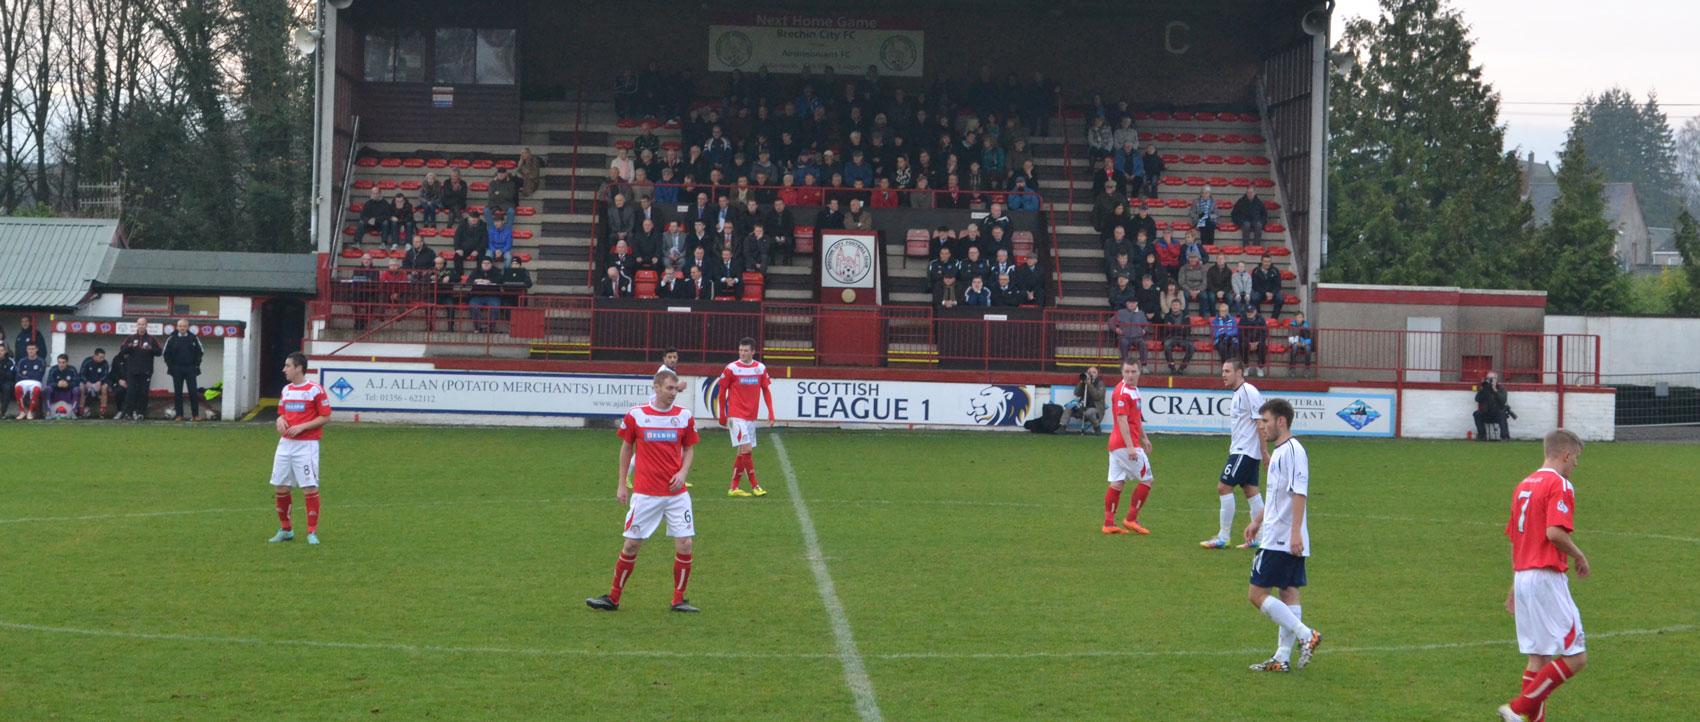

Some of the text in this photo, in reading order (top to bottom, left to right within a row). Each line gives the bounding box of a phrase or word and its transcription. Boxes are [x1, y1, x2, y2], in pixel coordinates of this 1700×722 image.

[756, 14, 878, 29] Next Home Game
[776, 28, 856, 41] Brechin City FC
[1164, 20, 1190, 54] C
[365, 378, 388, 390] A.J.
[391, 379, 438, 391] ALLAN
[441, 380, 499, 392] (POTATO
[502, 381, 594, 396] MERCHANTS)
[797, 381, 879, 396] SCOTTISH
[797, 396, 930, 421] LEAGUE 1
[303, 464, 311, 476] 8
[1223, 463, 1232, 476] 6
[684, 509, 692, 524] 6
[1517, 489, 1533, 533] 7
